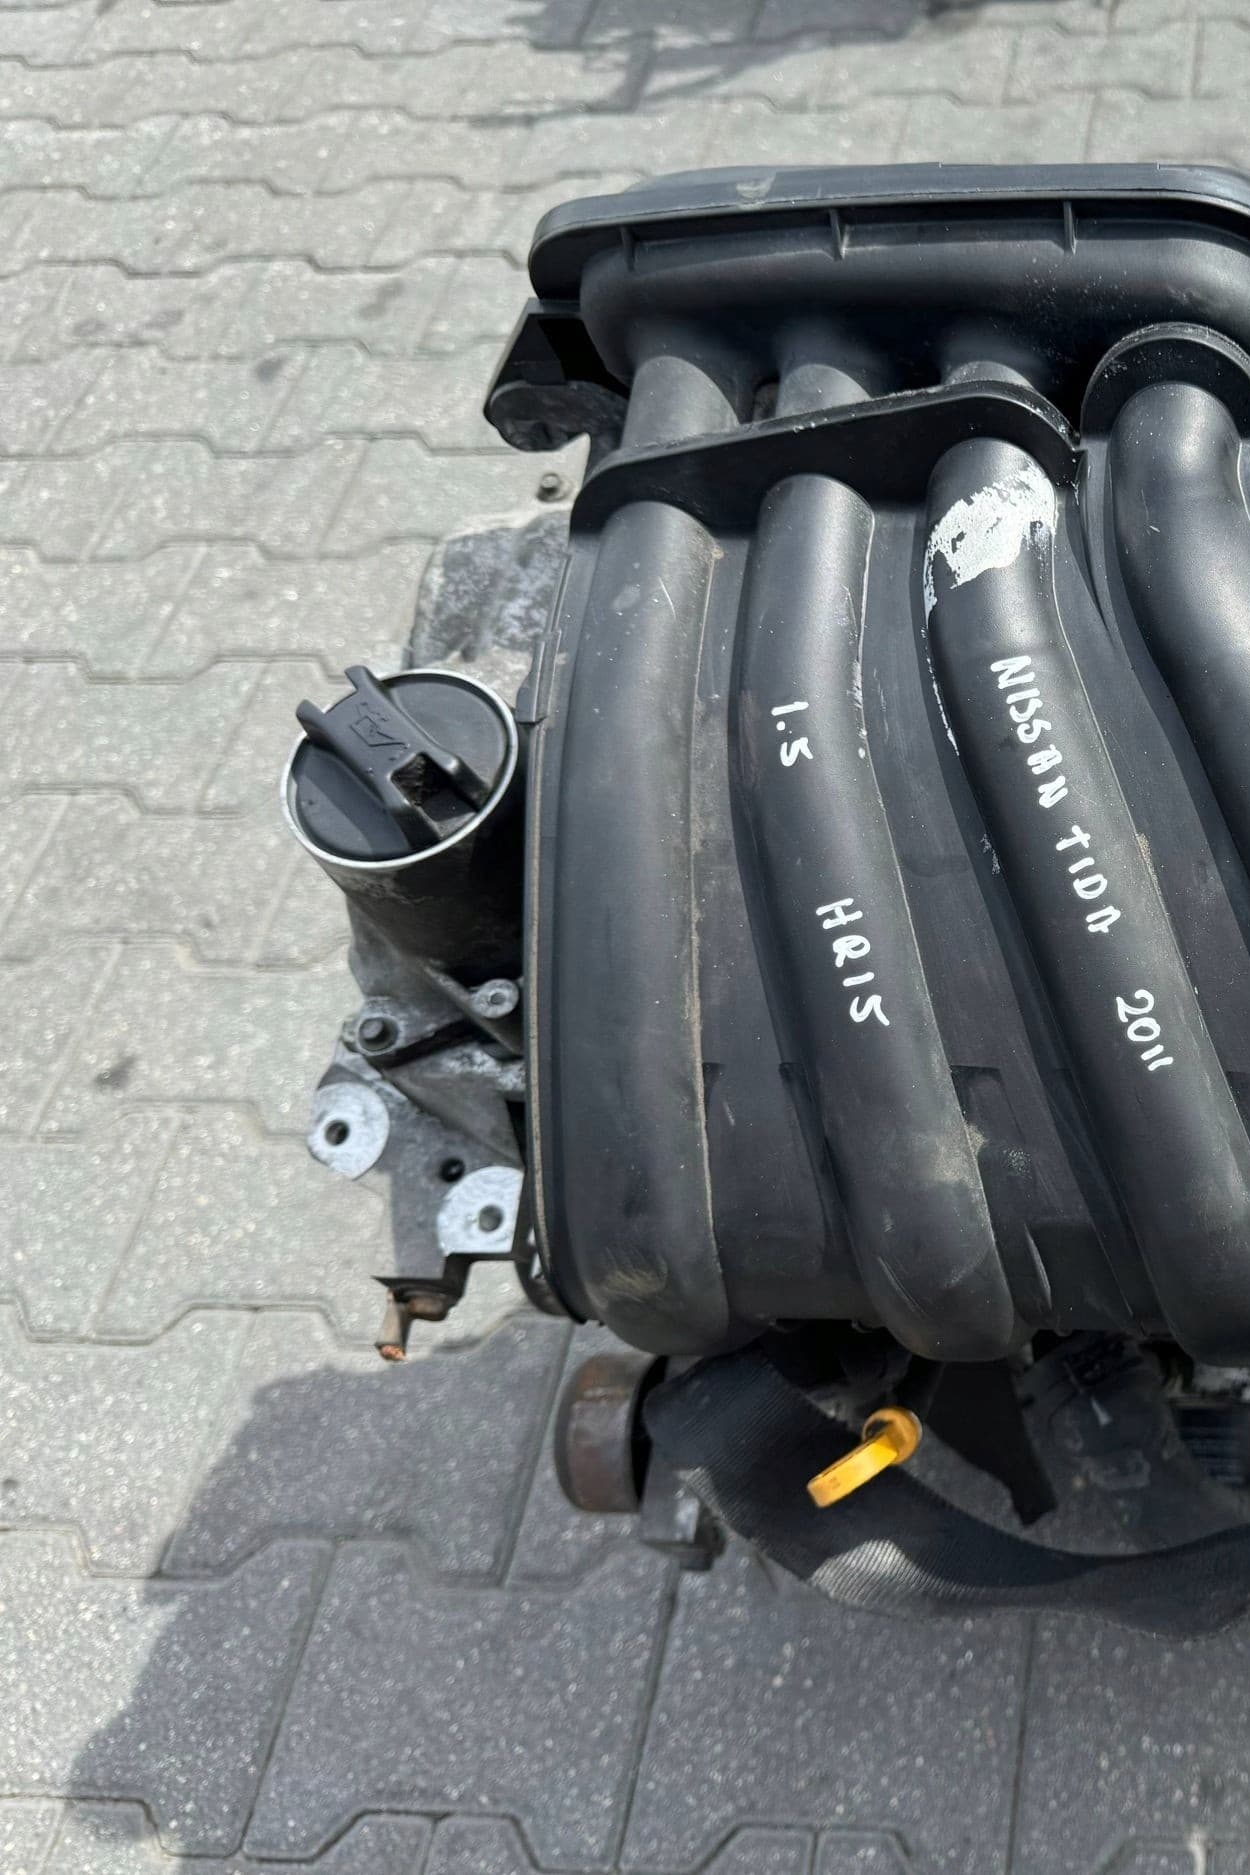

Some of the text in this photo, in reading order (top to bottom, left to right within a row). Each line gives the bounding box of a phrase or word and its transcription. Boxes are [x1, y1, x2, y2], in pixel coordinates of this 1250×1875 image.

[771, 701, 812, 767] 1.5
[991, 654, 1069, 809] NISSAN
[1116, 989, 1174, 1072] 2011
[815, 897, 890, 1027] HR15
